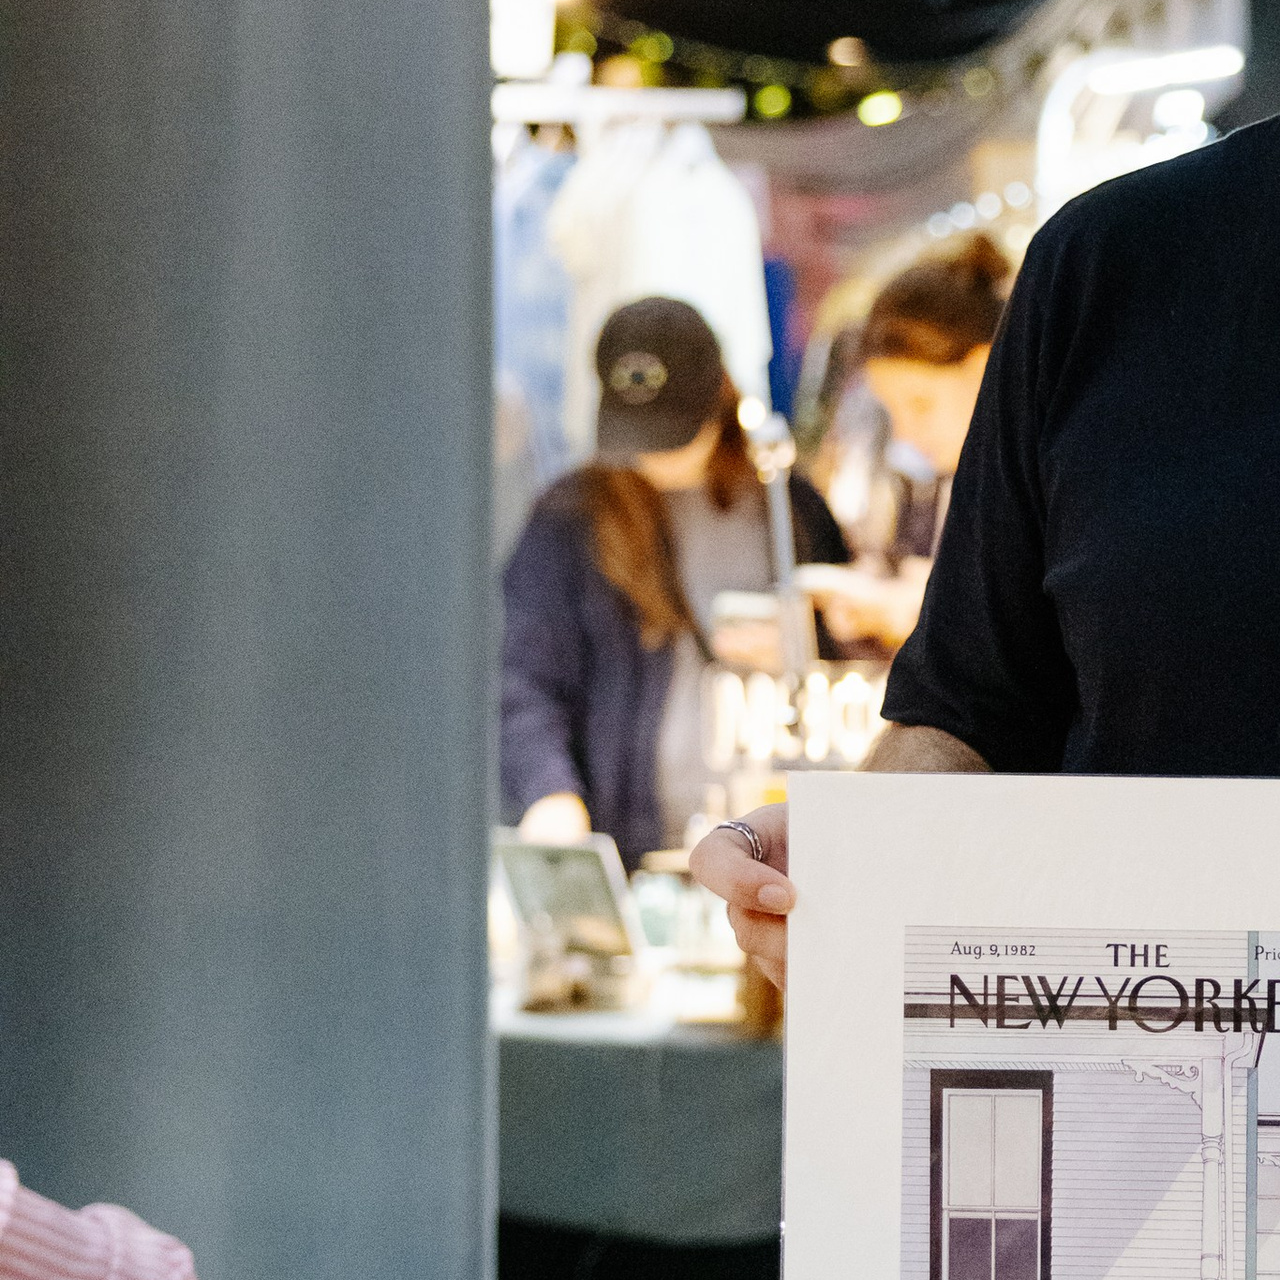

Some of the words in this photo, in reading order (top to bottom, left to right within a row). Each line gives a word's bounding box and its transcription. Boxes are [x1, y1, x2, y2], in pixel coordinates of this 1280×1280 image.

[950, 940, 985, 960] Aug.
[1105, 943, 1171, 968] THE
[949, 974, 1084, 1030] NEW
